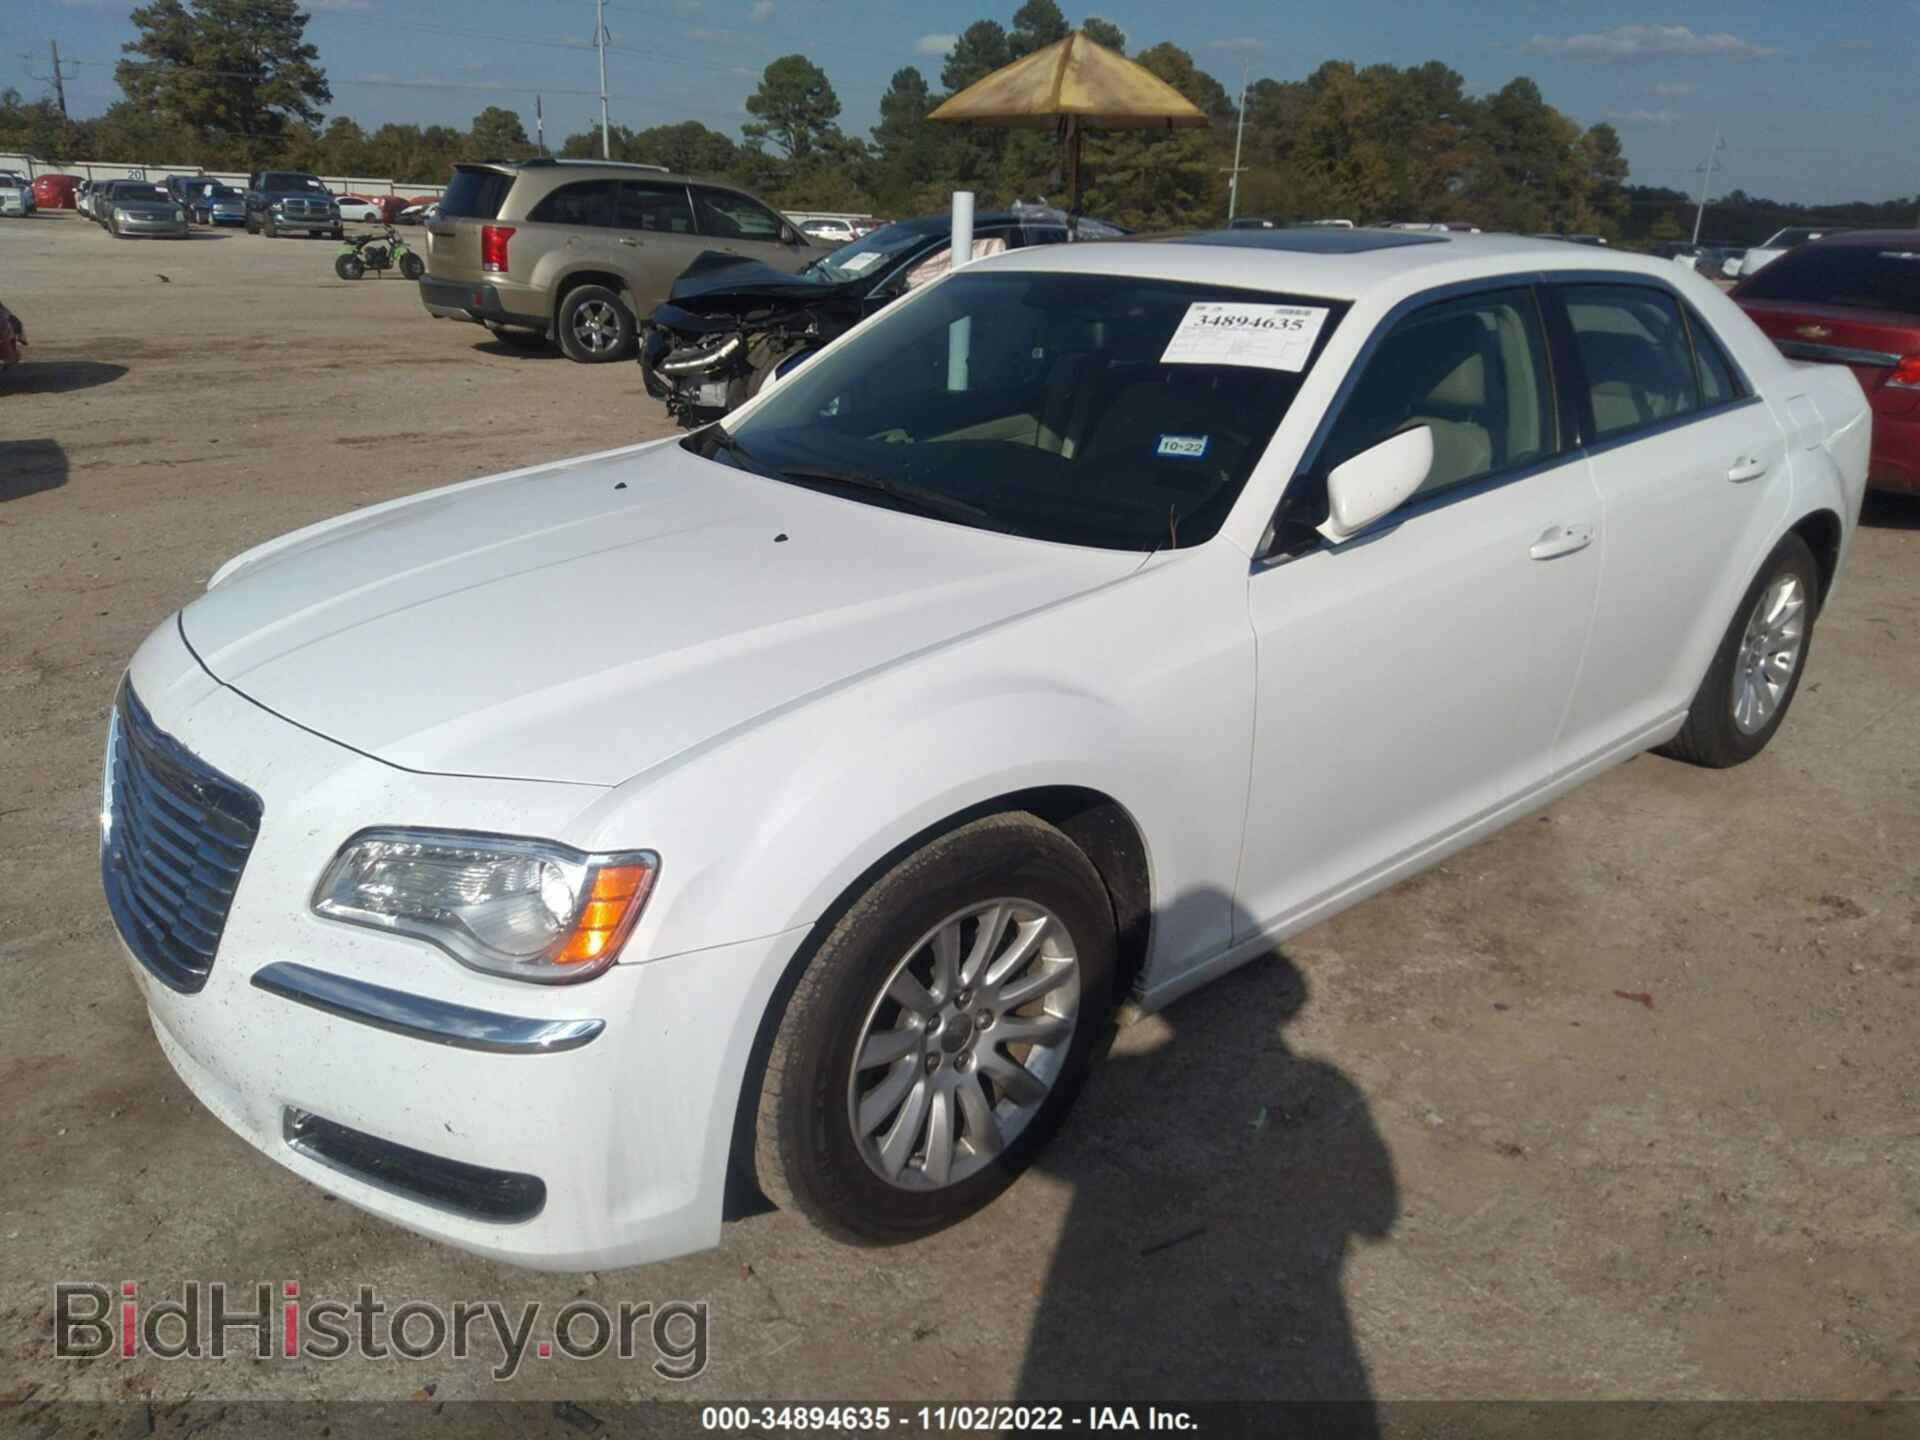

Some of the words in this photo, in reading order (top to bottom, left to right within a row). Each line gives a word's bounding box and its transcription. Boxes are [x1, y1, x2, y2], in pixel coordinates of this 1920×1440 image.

[127, 169, 142, 180] 20
[1193, 314, 1305, 331] 34894635
[1163, 441, 1203, 453] 10-22
